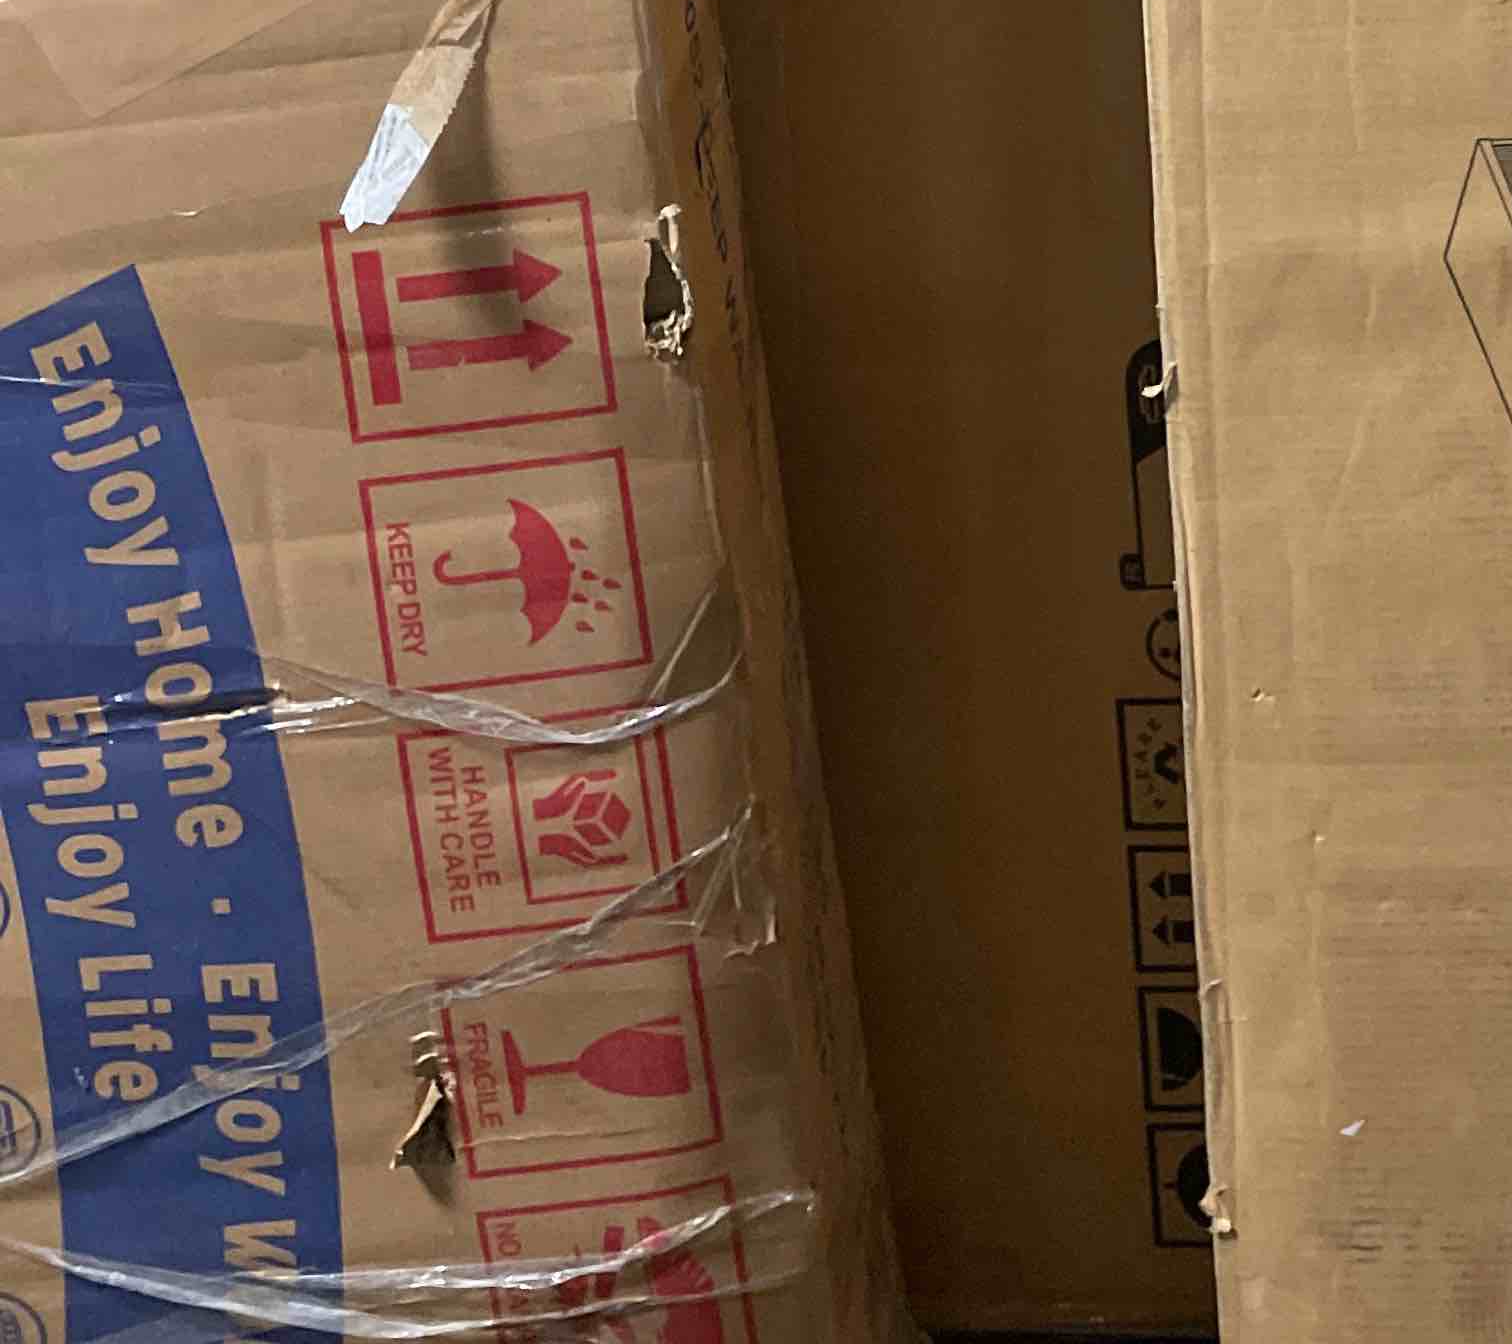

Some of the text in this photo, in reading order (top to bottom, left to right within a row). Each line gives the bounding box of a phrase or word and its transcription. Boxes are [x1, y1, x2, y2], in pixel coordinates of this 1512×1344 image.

[384, 522, 428, 657] KEEP DRY
[30, 320, 180, 567] Enjoy
[126, 590, 245, 849] Home
[193, 962, 302, 1197] Enjoy
[428, 746, 475, 913] WITH CARE
[461, 765, 500, 889] HANDLE
[24, 695, 173, 1101] Enjoy Life
[463, 1021, 504, 1129] FRAGILE
[498, 1221, 522, 1257] NO
